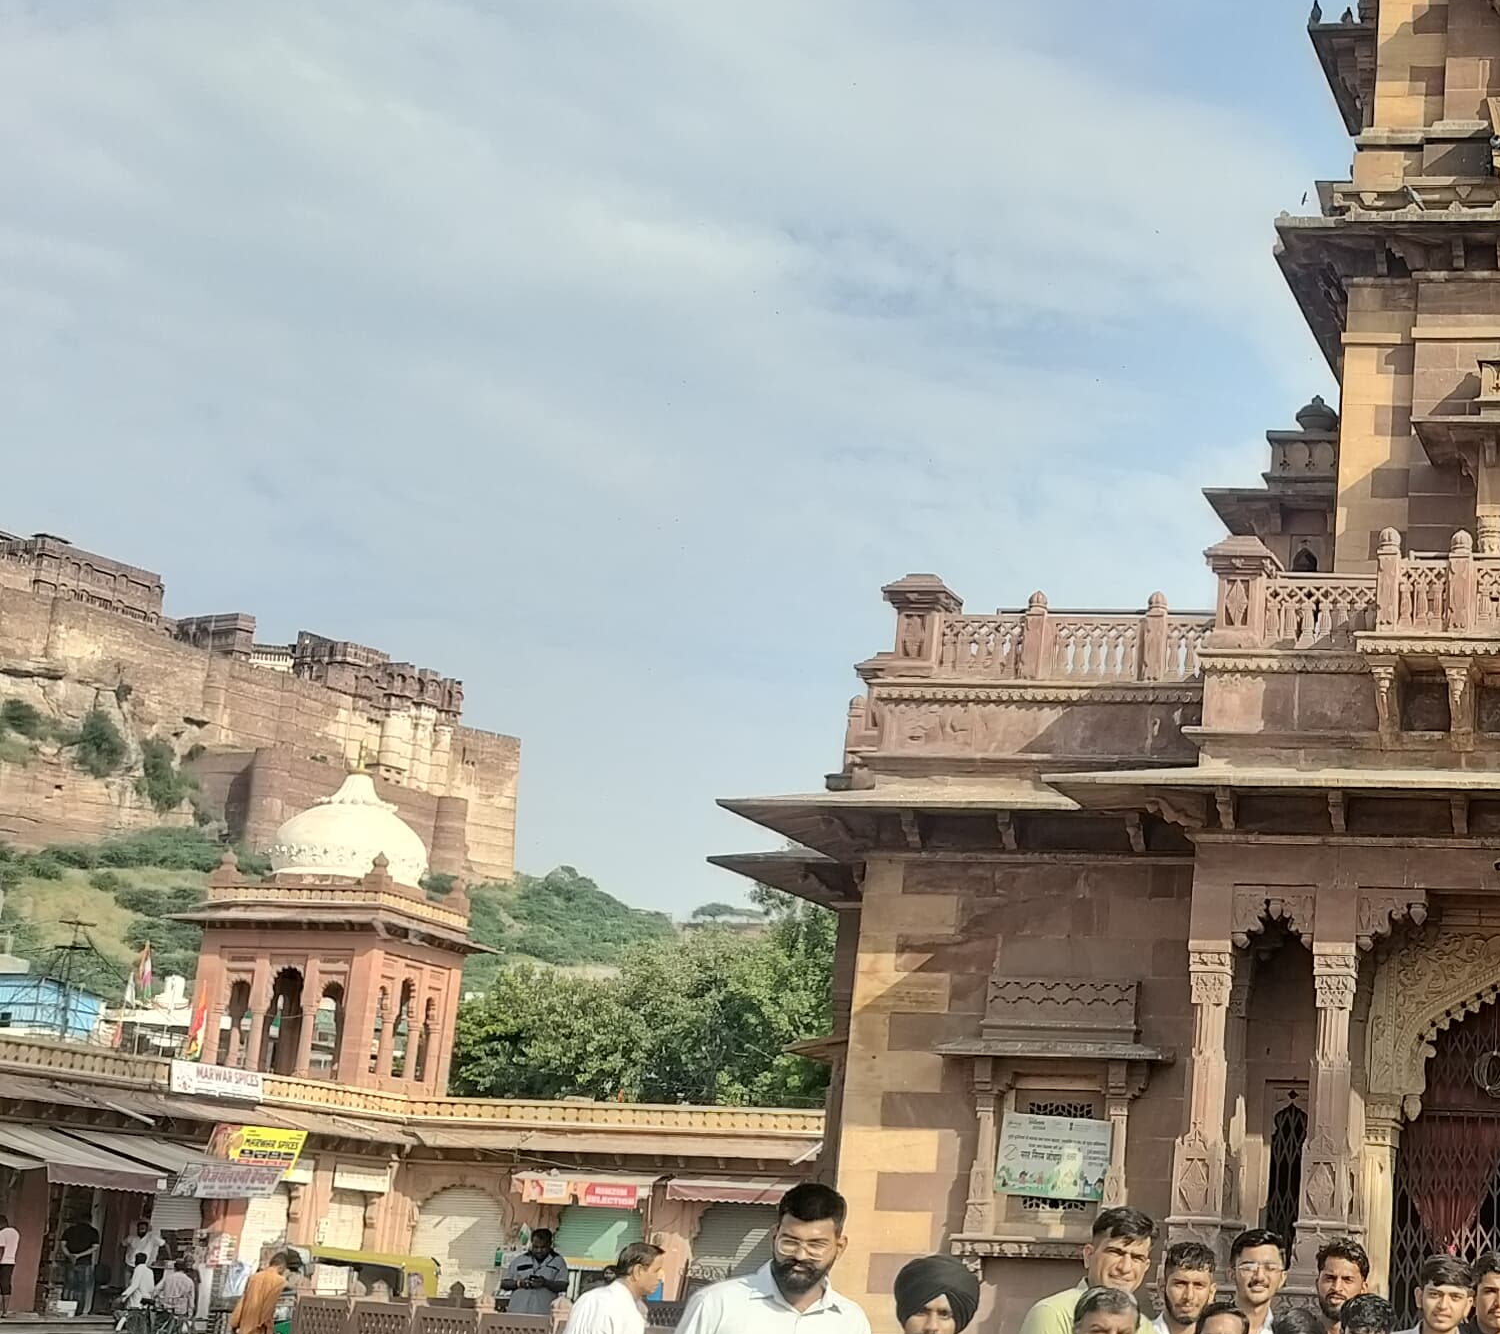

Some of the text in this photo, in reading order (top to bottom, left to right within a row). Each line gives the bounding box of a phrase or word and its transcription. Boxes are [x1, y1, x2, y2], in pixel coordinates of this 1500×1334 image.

[196, 1066, 259, 1087] MARWAR SPICES
[244, 1138, 300, 1151] MARWAR SPICES
[586, 1195, 635, 1205] SELECTION
